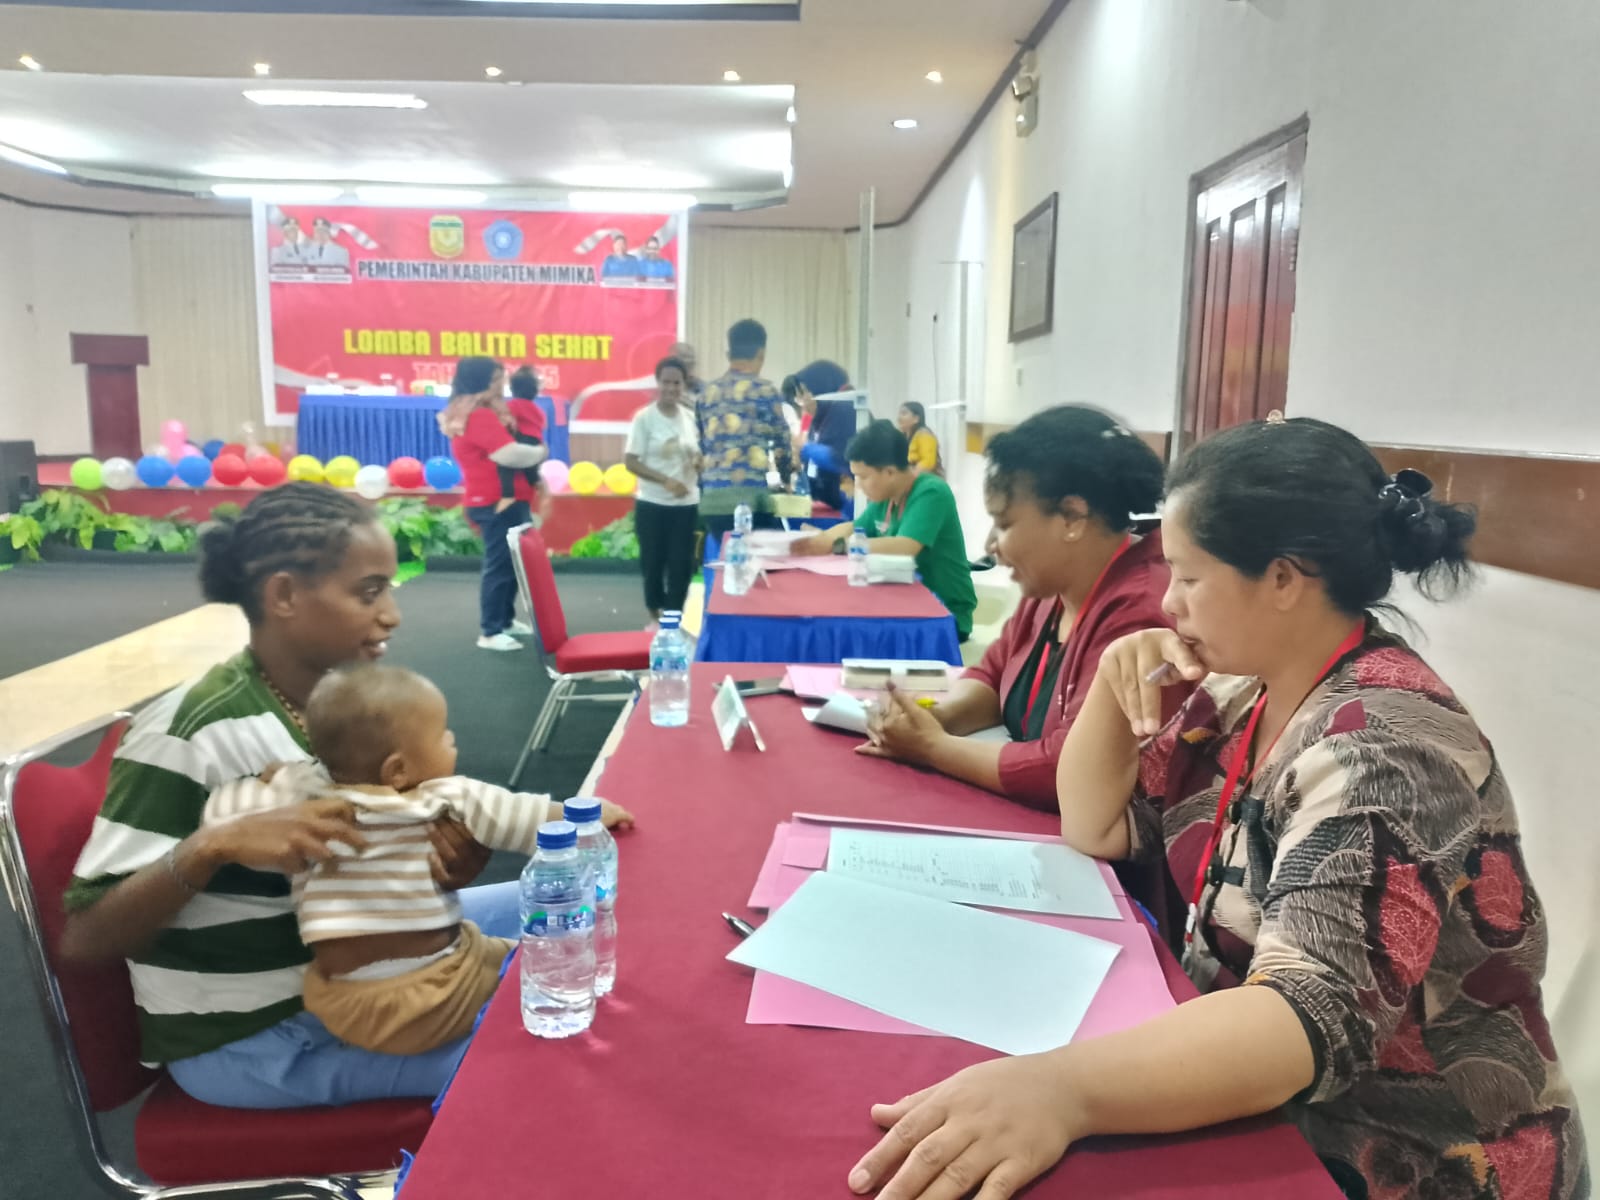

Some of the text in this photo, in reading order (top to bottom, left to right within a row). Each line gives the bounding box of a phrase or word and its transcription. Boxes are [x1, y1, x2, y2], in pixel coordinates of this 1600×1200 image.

[358, 261, 449, 281] PEMERINTAH
[453, 263, 536, 283] KABUPATEN
[539, 265, 596, 284] MIMIKA
[344, 329, 613, 360] LOMBA BALITA SEHAT
